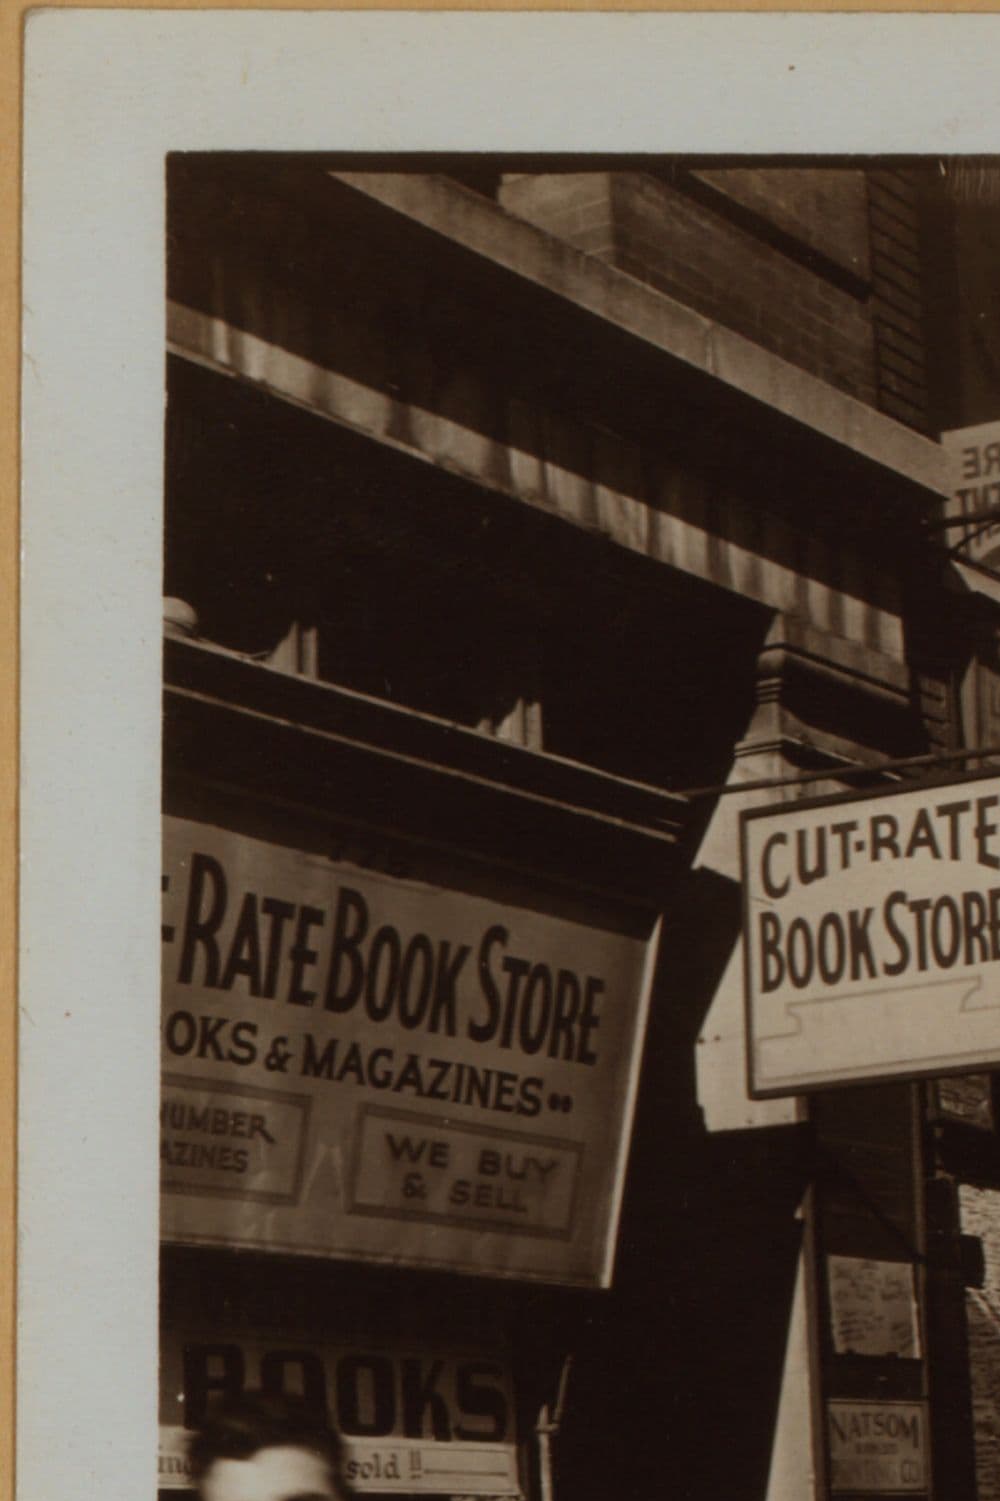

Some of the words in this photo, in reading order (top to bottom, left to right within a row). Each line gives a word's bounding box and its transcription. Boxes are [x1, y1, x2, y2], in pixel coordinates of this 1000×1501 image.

[264, 1035, 293, 1073] &
[301, 1033, 544, 1118] MAGAZINES
[162, 1100, 279, 1145] UMBER
[386, 1133, 450, 1170] WE
[478, 1149, 559, 1185] BUY
[401, 1172, 426, 1201] &
[450, 1179, 529, 1214] SELL
[183, 1343, 509, 1441] BOOKS
